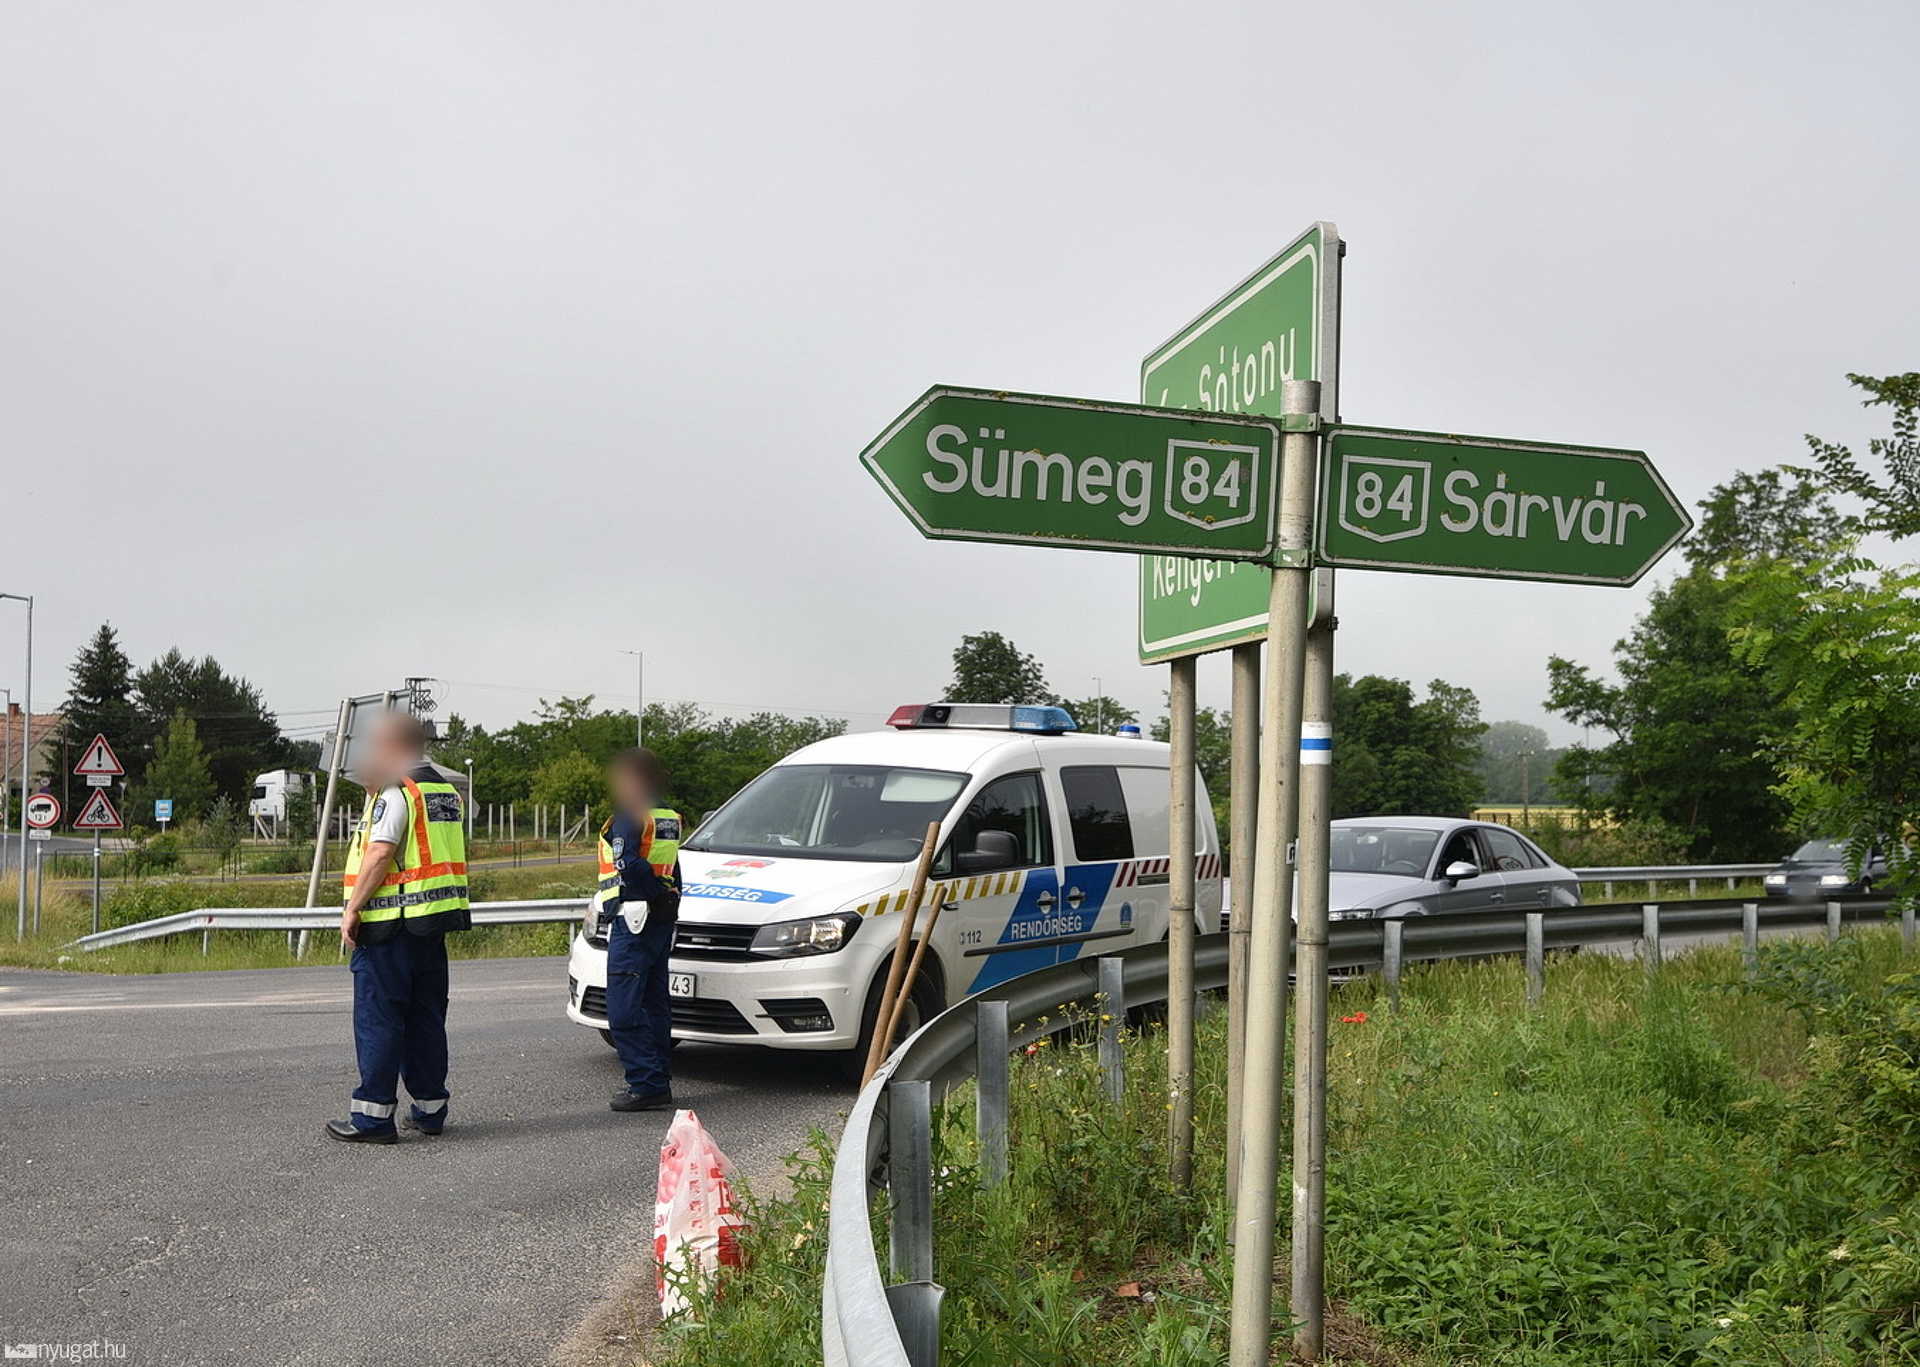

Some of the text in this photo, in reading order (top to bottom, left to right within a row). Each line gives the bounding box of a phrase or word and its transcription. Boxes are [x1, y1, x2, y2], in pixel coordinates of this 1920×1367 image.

[922, 424, 1241, 527] Sümeg 84
[1355, 470, 1648, 546] 84 Sárvár
[967, 930, 981, 944] 112
[1011, 912, 1082, 940] RENDŐRSÉG
